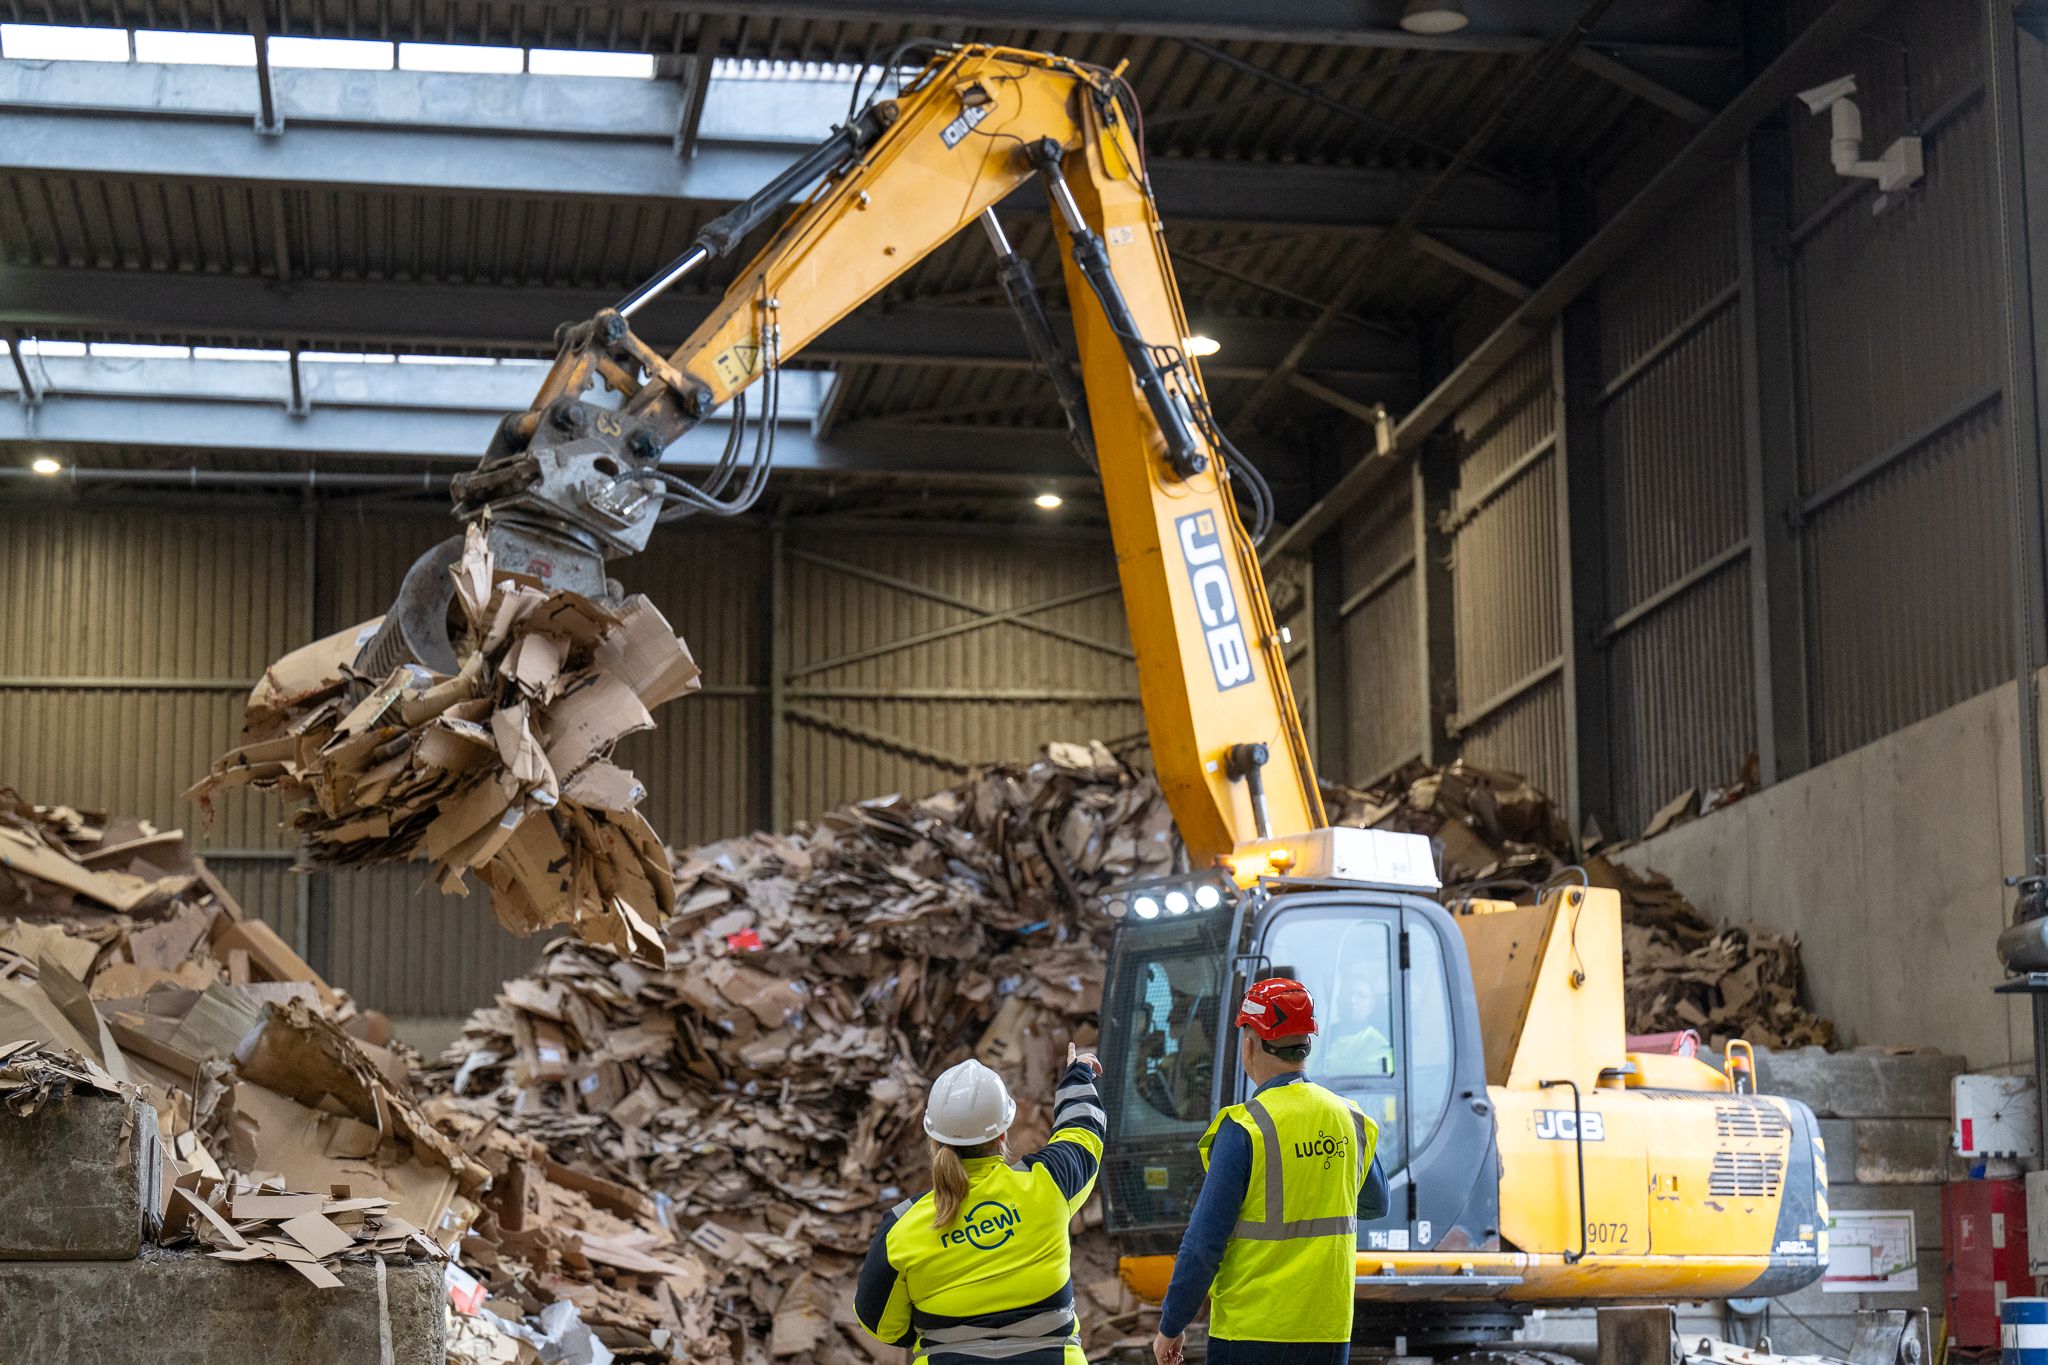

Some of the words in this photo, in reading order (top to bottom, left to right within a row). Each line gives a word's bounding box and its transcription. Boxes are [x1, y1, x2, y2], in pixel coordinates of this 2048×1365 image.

[1179, 514, 1251, 688] JCB
[1536, 1110, 1604, 1140] JCB
[1294, 1138, 1336, 1159] LUCO
[940, 1204, 1022, 1249] renewi
[1587, 1222, 1629, 1243] 9072
